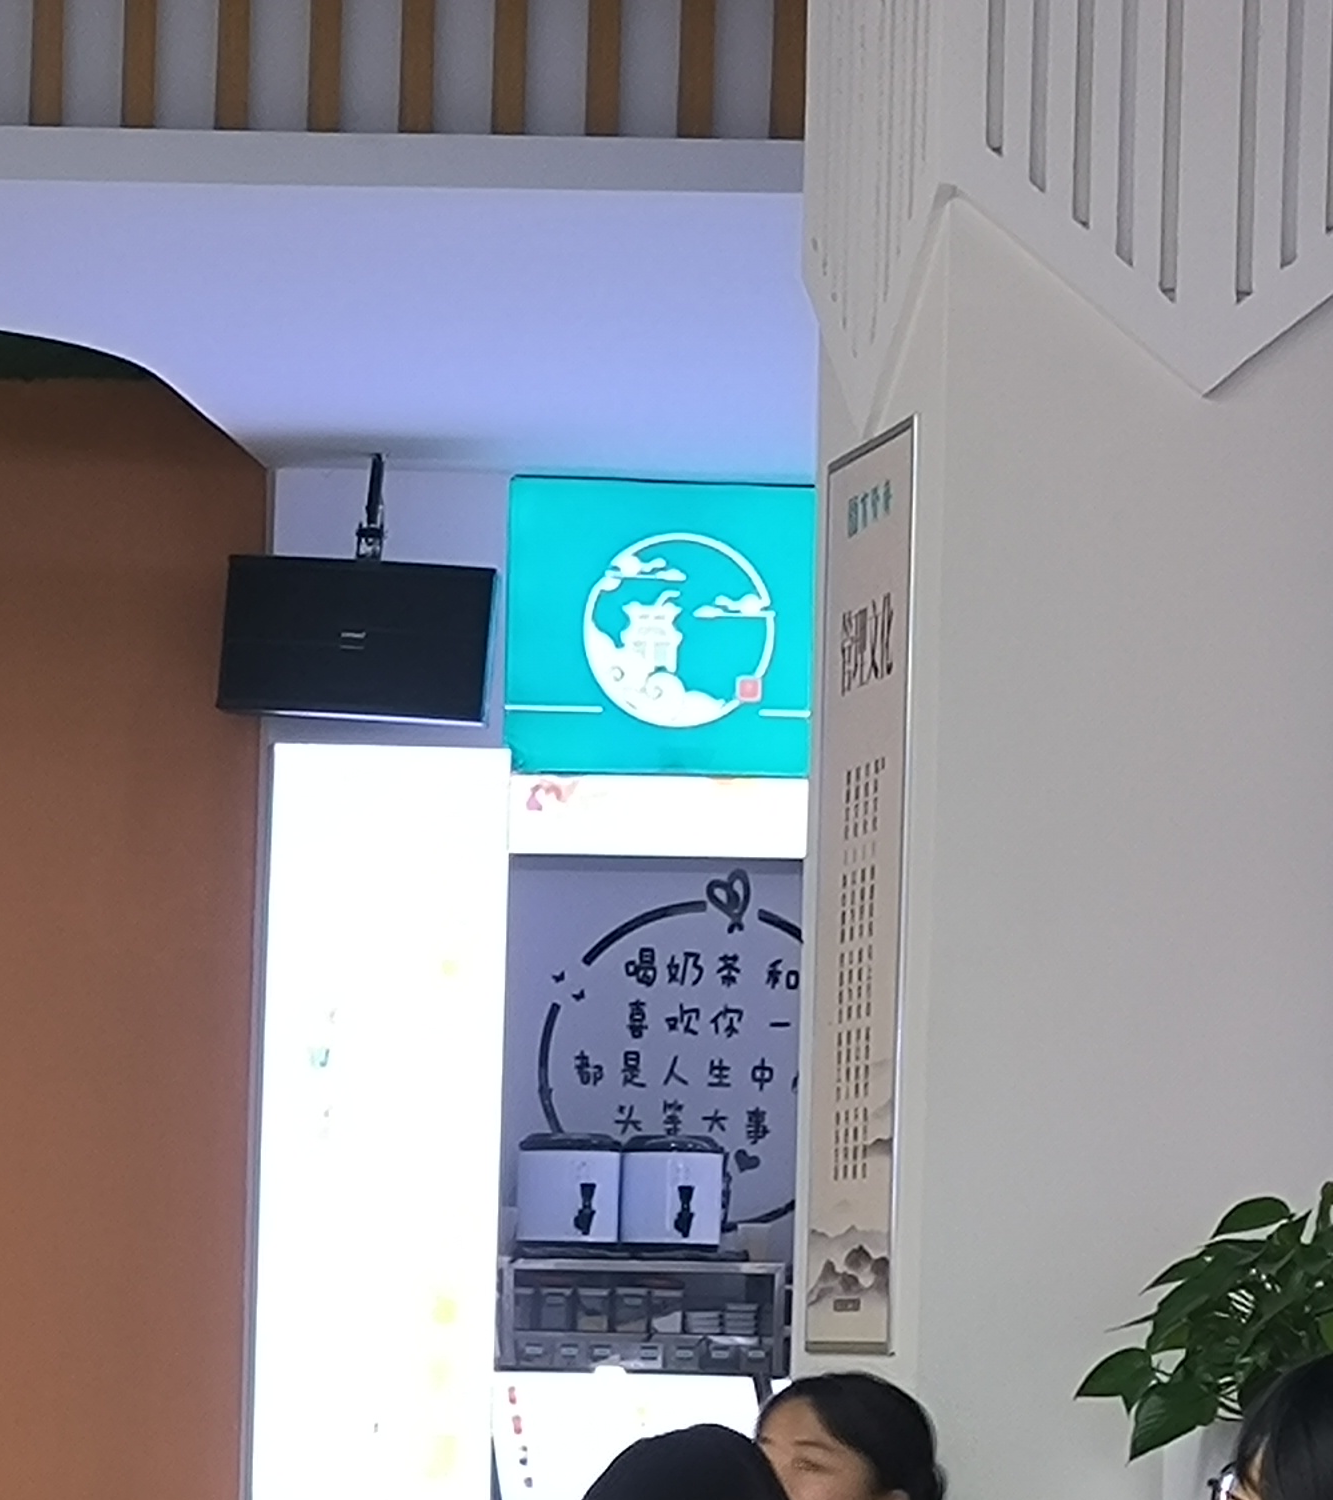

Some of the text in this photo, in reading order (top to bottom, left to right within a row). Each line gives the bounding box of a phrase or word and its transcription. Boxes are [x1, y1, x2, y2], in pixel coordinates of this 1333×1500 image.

[840, 592, 894, 698] 管理文化
[624, 946, 800, 990] 喝奶茶和
[626, 999, 792, 1039] 喜欢你一
[573, 1049, 800, 1095] 都是人生中
[613, 1100, 771, 1146] 头等大事
